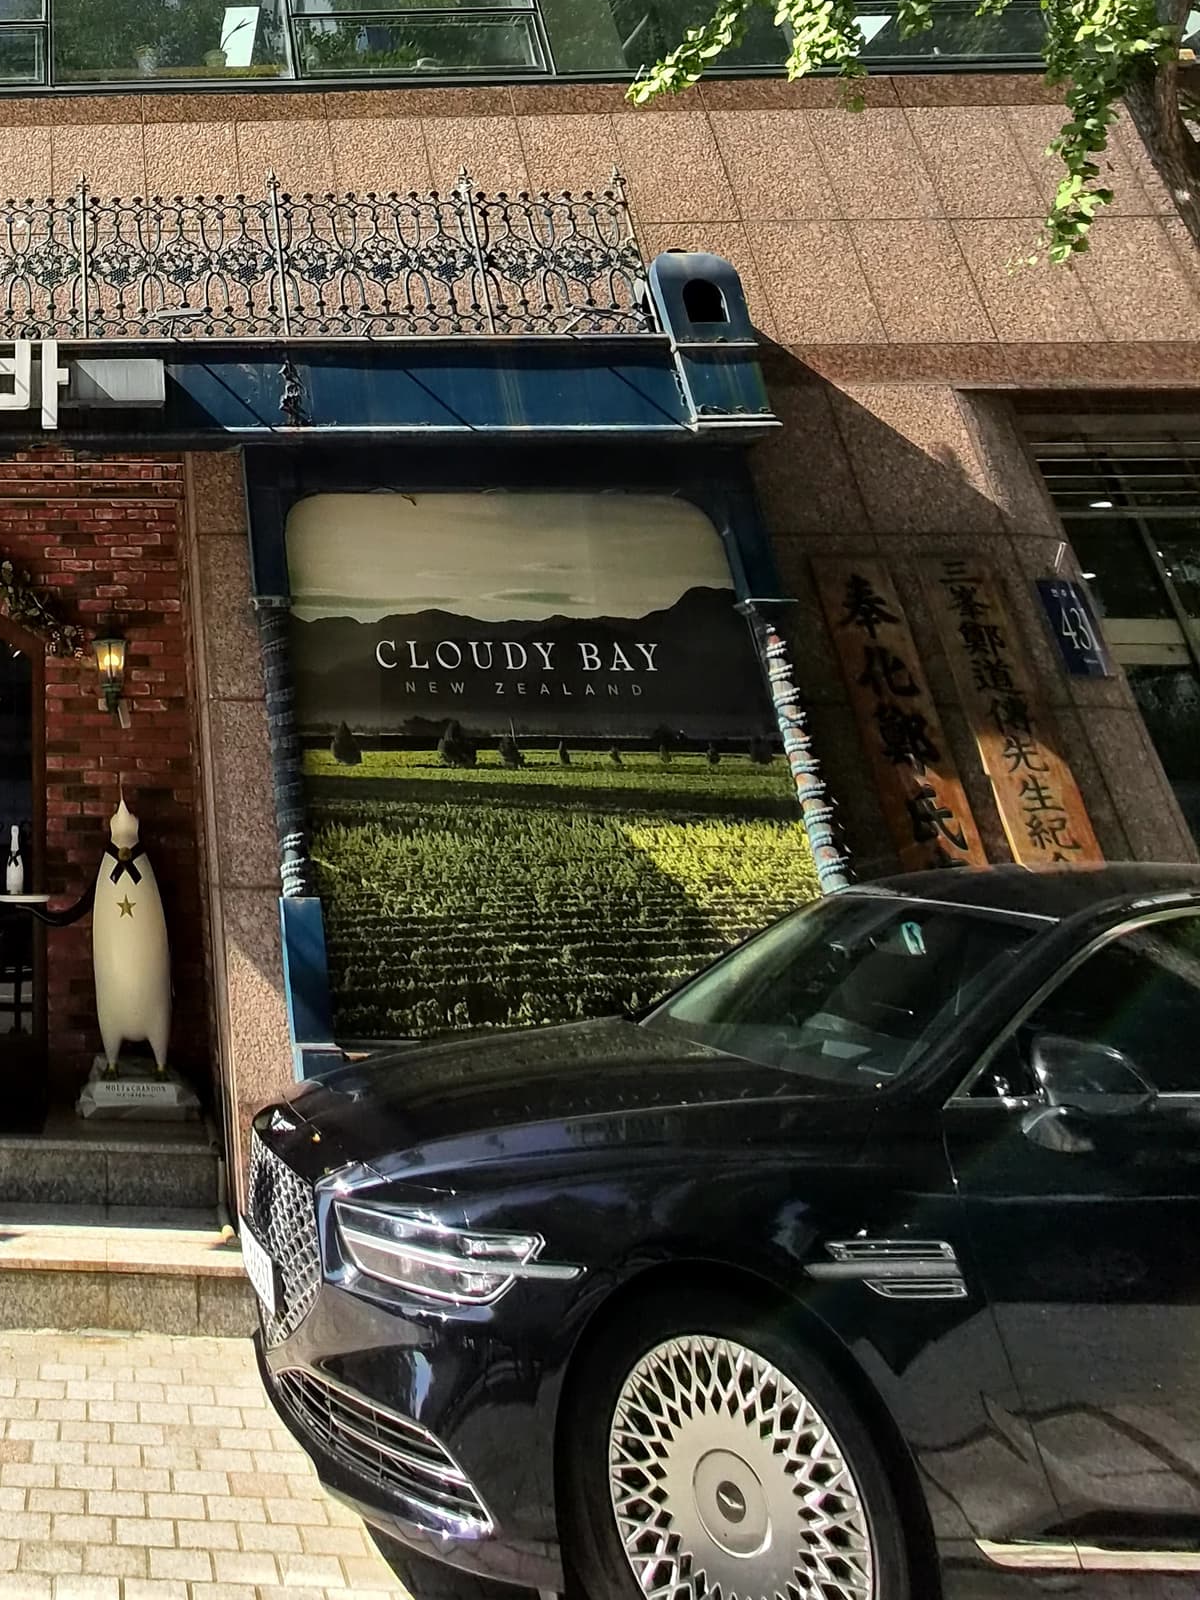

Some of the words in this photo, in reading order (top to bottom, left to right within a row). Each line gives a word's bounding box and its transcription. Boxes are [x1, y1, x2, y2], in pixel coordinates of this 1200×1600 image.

[1060, 606, 1101, 651] 431
[375, 639, 557, 671] CLOUDY
[577, 641, 660, 672] BAY
[405, 681, 466, 694] NEW
[495, 681, 643, 697] ZEALAND
[840, 573, 970, 866] 奉化鄭氏
